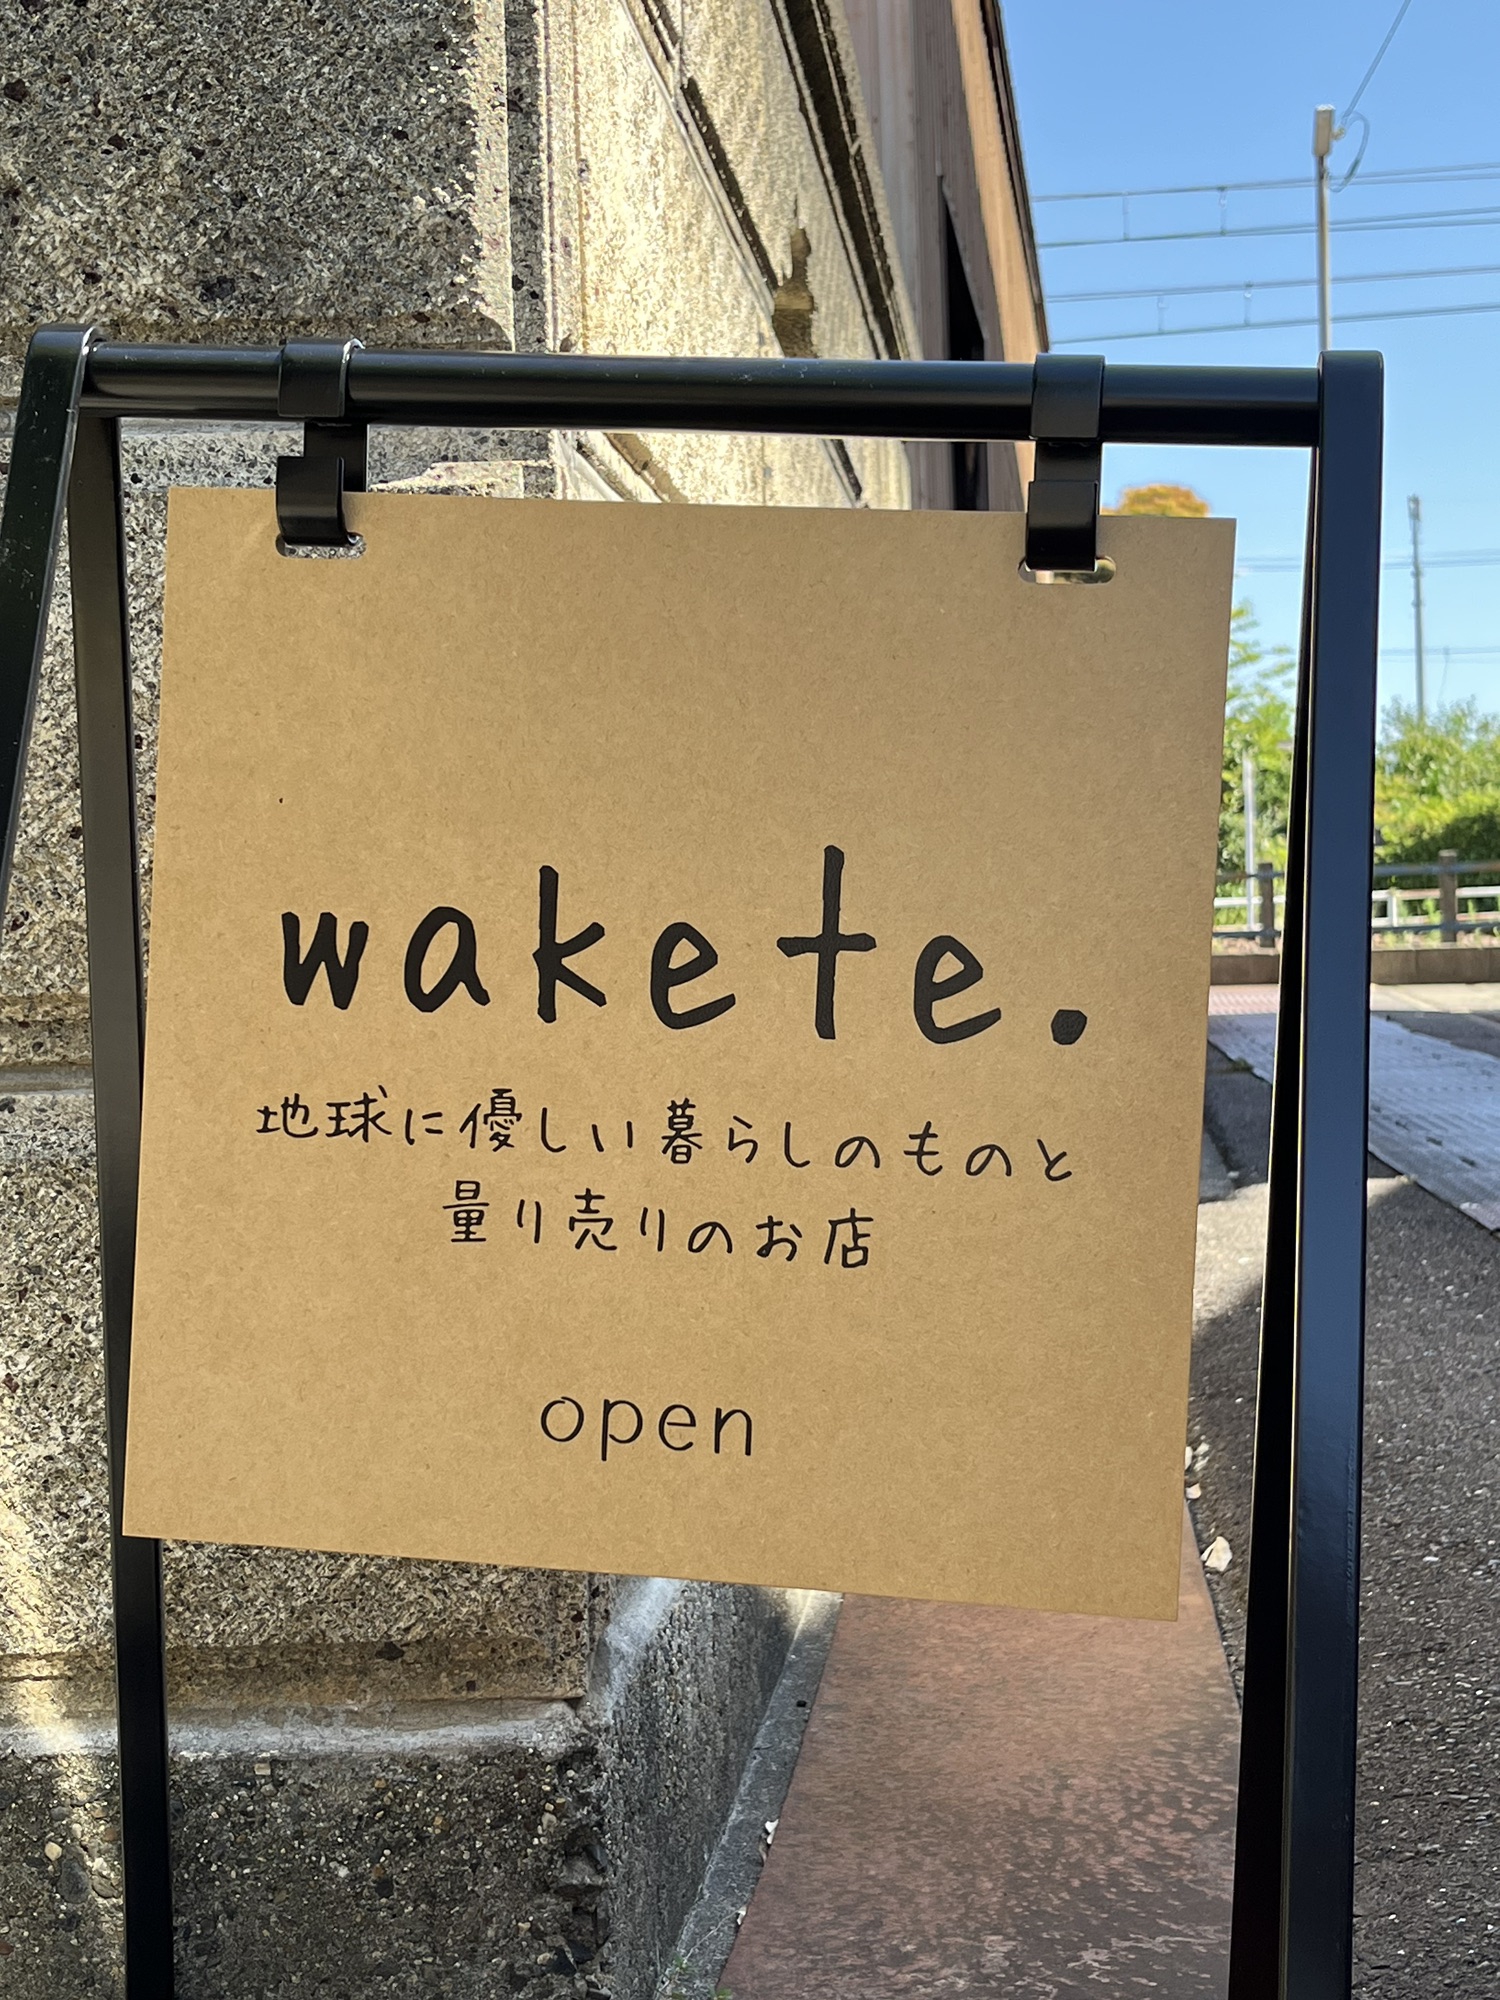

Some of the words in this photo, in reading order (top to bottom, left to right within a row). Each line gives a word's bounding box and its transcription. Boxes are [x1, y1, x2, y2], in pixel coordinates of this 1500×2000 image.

[280, 843, 1089, 1047] wakete.
[255, 1084, 1074, 1183] 地球に優しい暮らしのものと
[442, 1179, 875, 1269] 量り売りのお店
[540, 1396, 754, 1462] open
